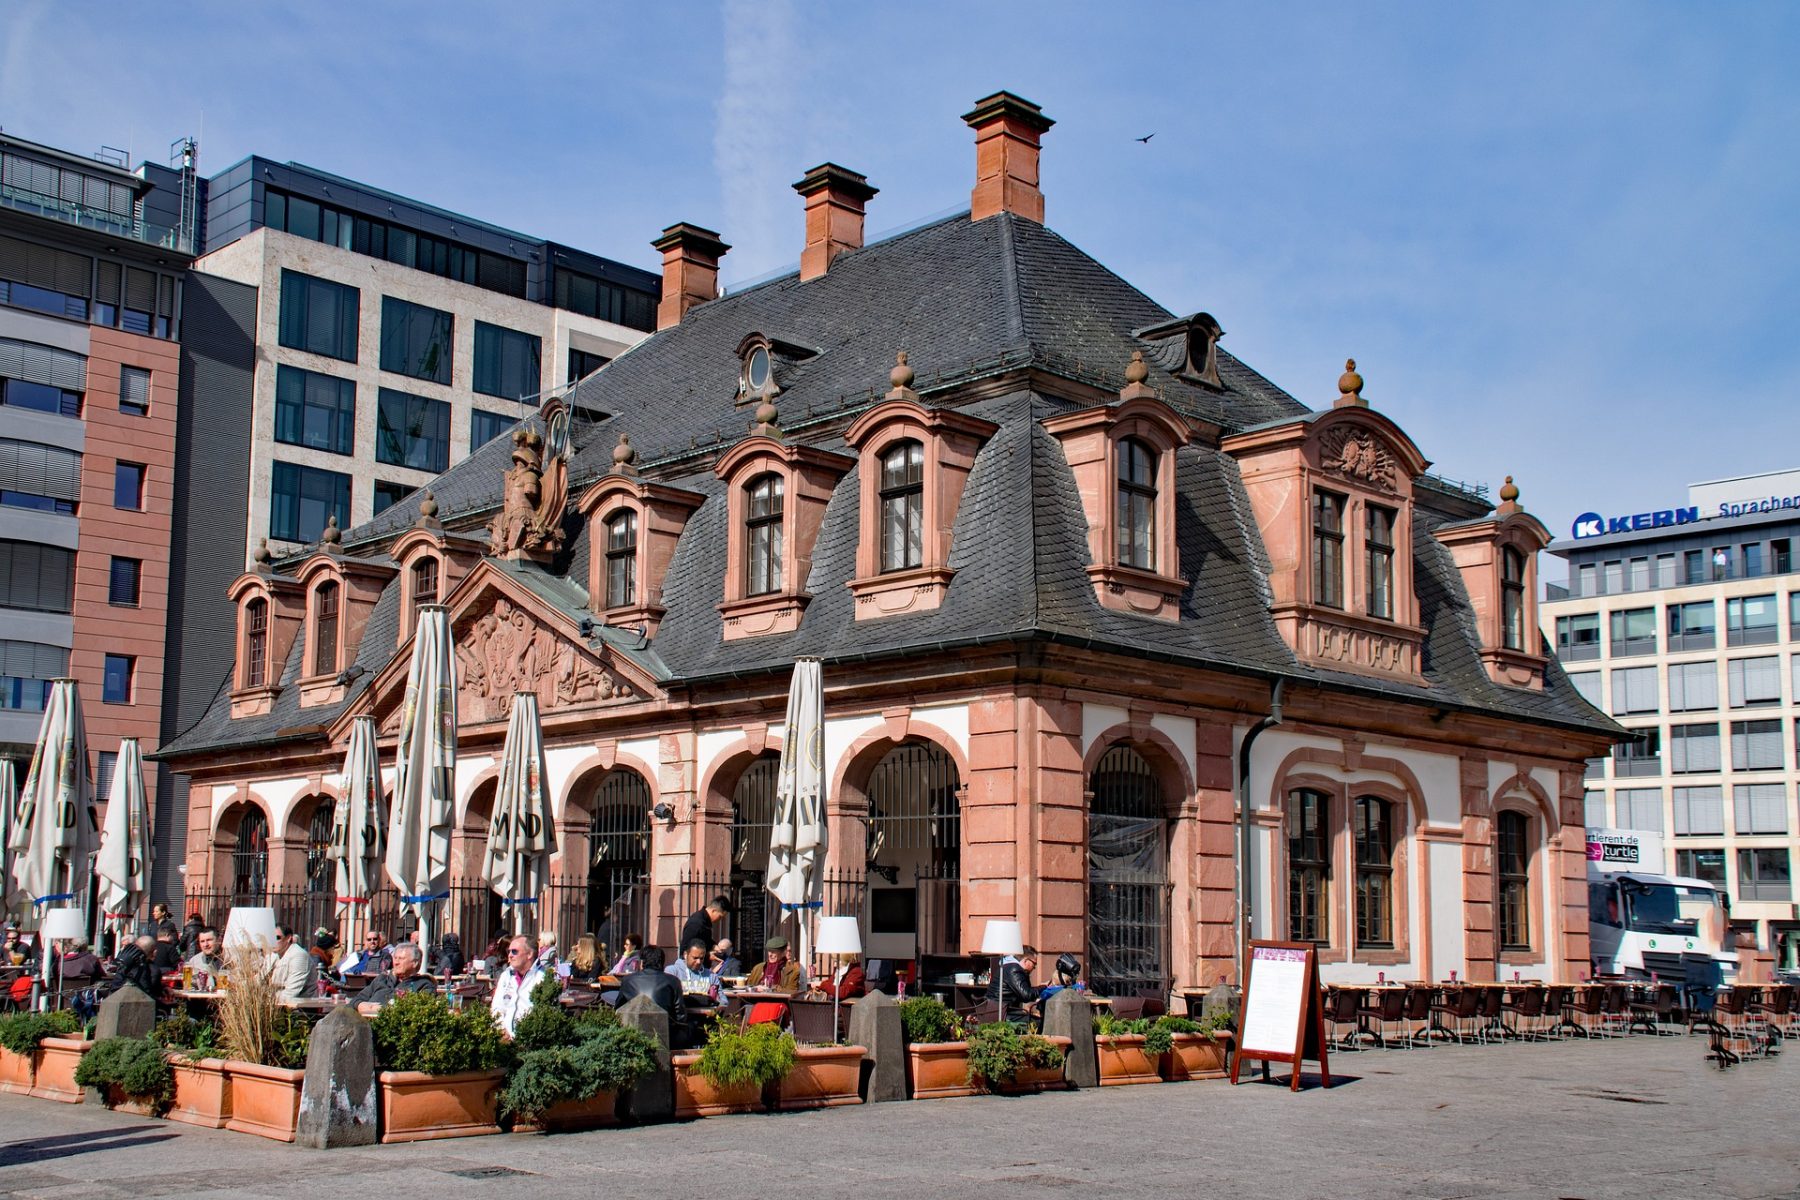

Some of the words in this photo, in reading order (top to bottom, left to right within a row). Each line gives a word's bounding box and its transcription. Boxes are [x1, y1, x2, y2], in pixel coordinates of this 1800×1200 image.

[1577, 520, 1600, 537] K
[1609, 506, 1698, 533] KERN
[1586, 833, 1638, 844] rtlerent.de
[1604, 845, 1638, 857] turtle
